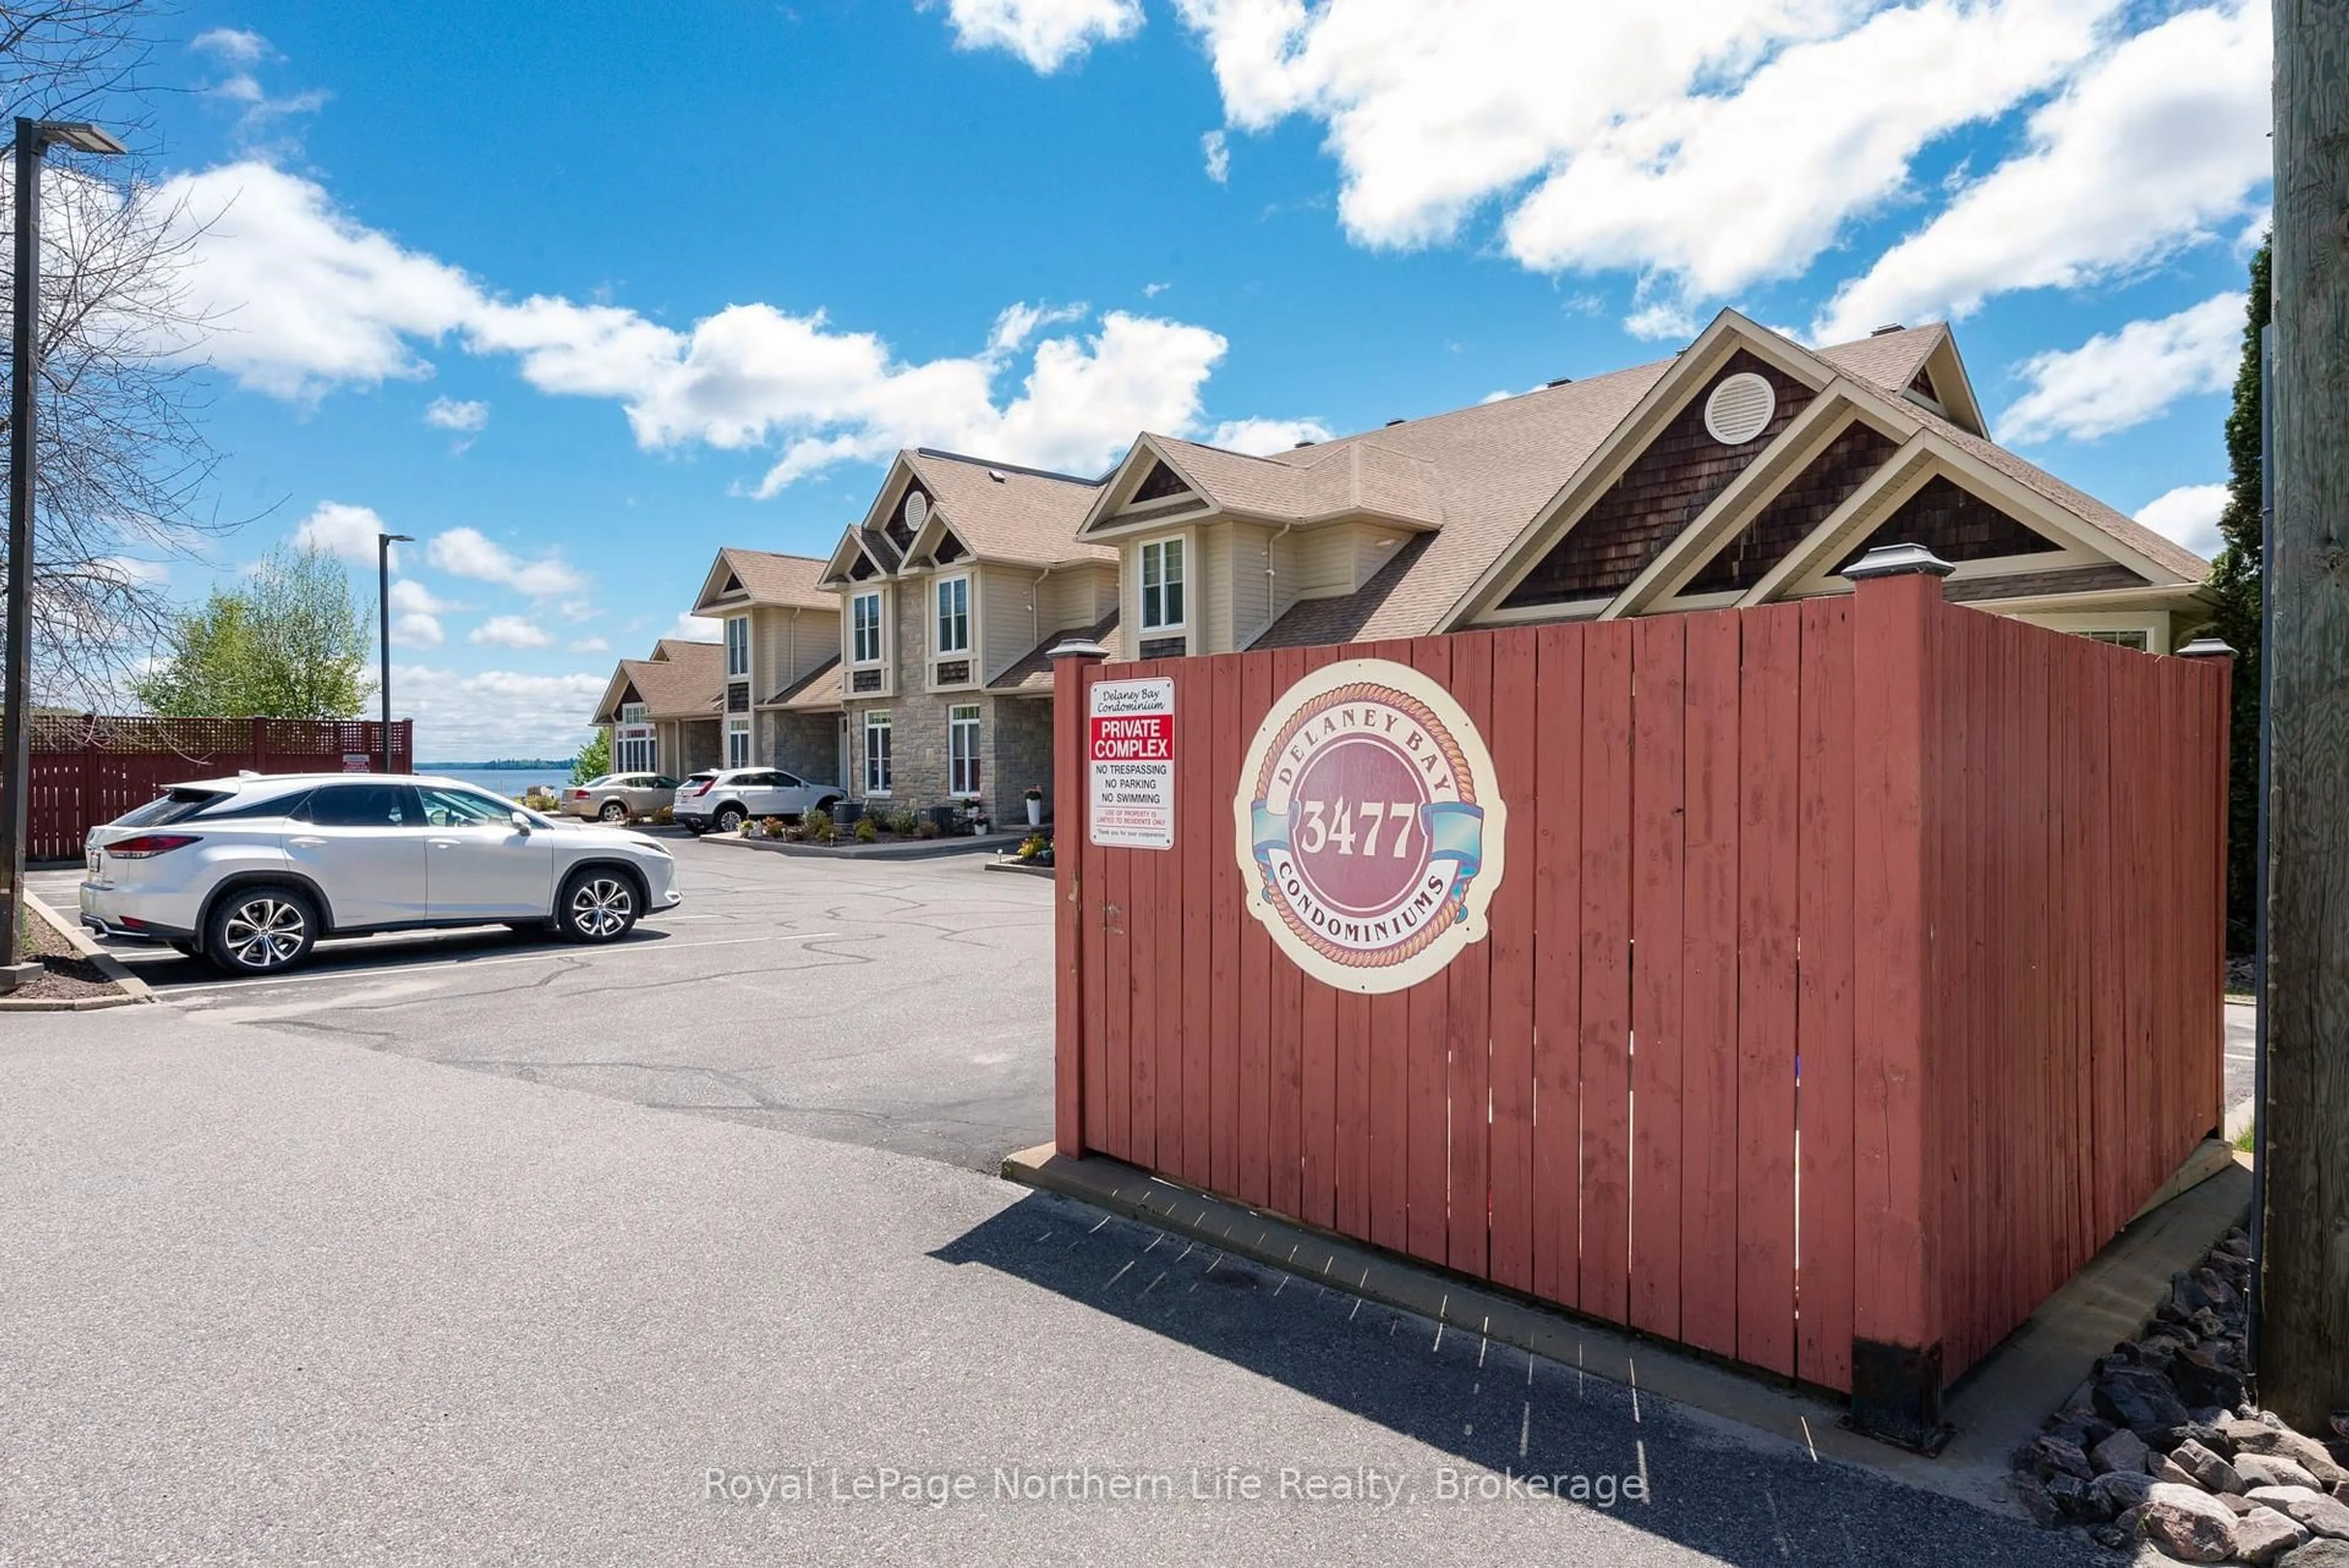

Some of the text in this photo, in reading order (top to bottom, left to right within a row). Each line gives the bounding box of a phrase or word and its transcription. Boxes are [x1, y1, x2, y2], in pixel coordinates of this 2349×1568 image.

[1103, 689, 1160, 701] Delaney Bay
[1097, 701, 1165, 713] Condominium
[1101, 719, 1161, 738] PRIVATE
[1094, 739, 1168, 758] COMPLEX
[1278, 708, 1452, 792] DELANEY BAY
[1096, 765, 1167, 775] NO TRESPASSING
[1105, 779, 1156, 789] NO PARKING
[1102, 793, 1160, 804] NO SWIMMING
[1301, 796, 1416, 859] 3477
[1278, 860, 1444, 942] CONDOMINIUMS
